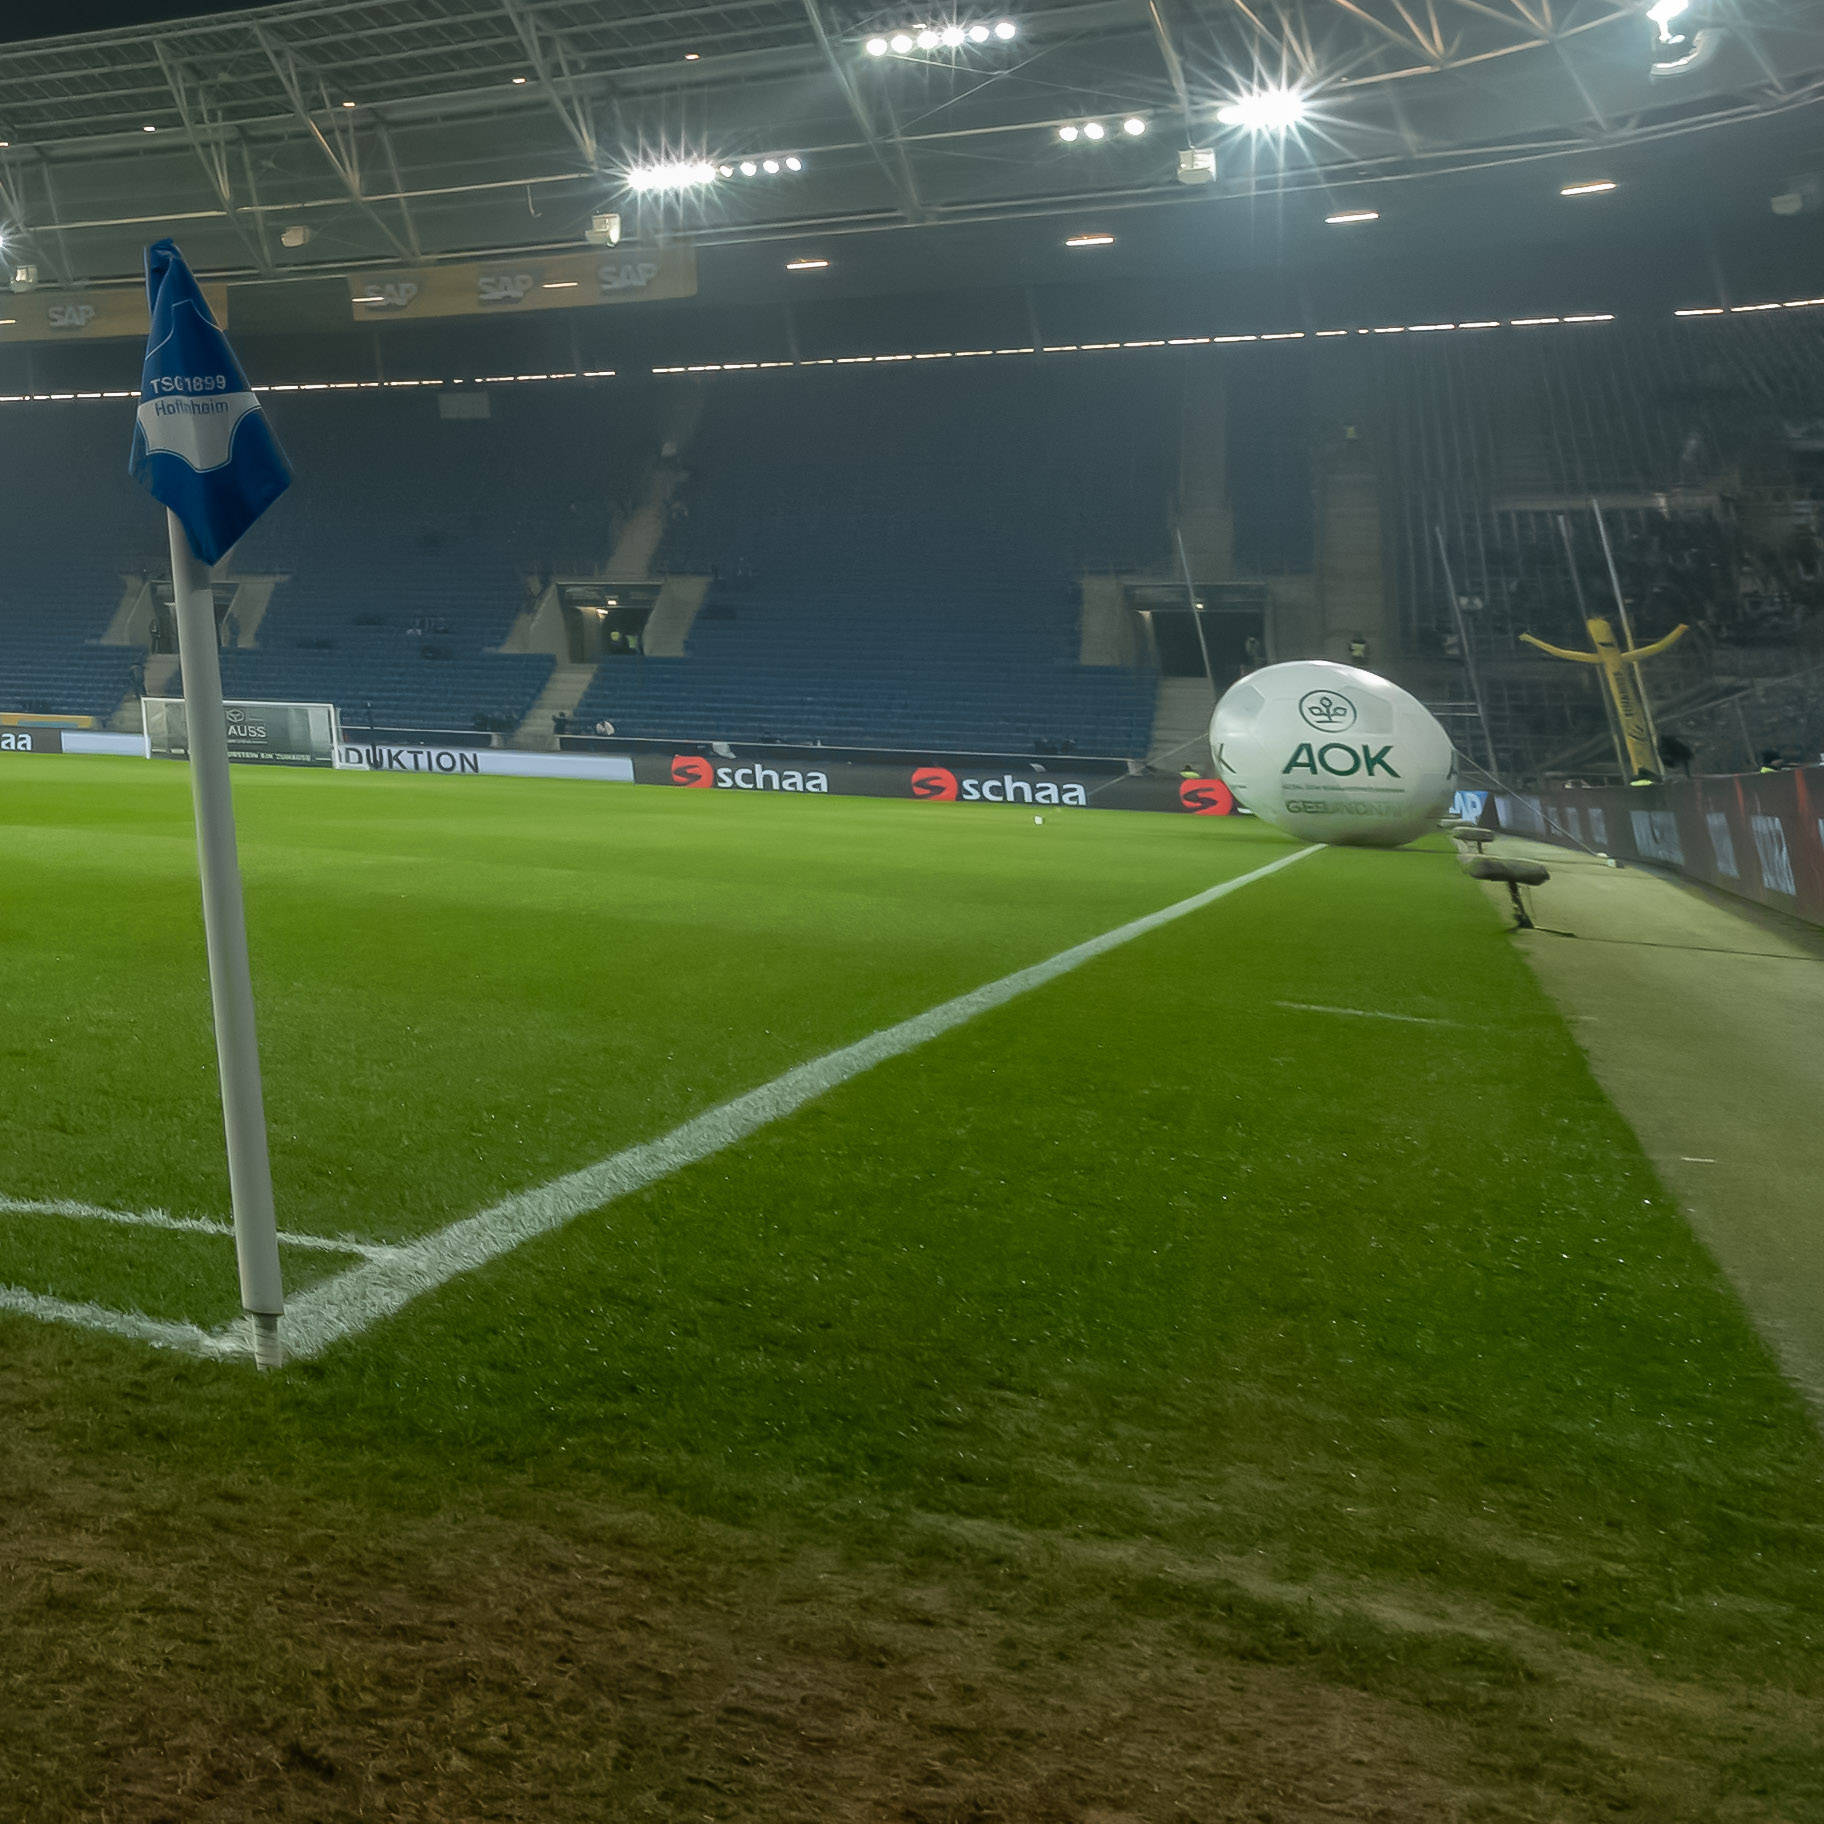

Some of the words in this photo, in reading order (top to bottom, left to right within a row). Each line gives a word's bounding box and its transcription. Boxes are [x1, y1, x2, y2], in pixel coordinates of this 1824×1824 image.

[478, 275, 535, 302] SAP
[598, 262, 658, 291] SAP
[47, 304, 96, 327] SAP
[344, 746, 480, 774] DUKTION
[1282, 742, 1402, 778] AOK
[716, 762, 829, 794] schaa
[961, 774, 1088, 806] schaa
